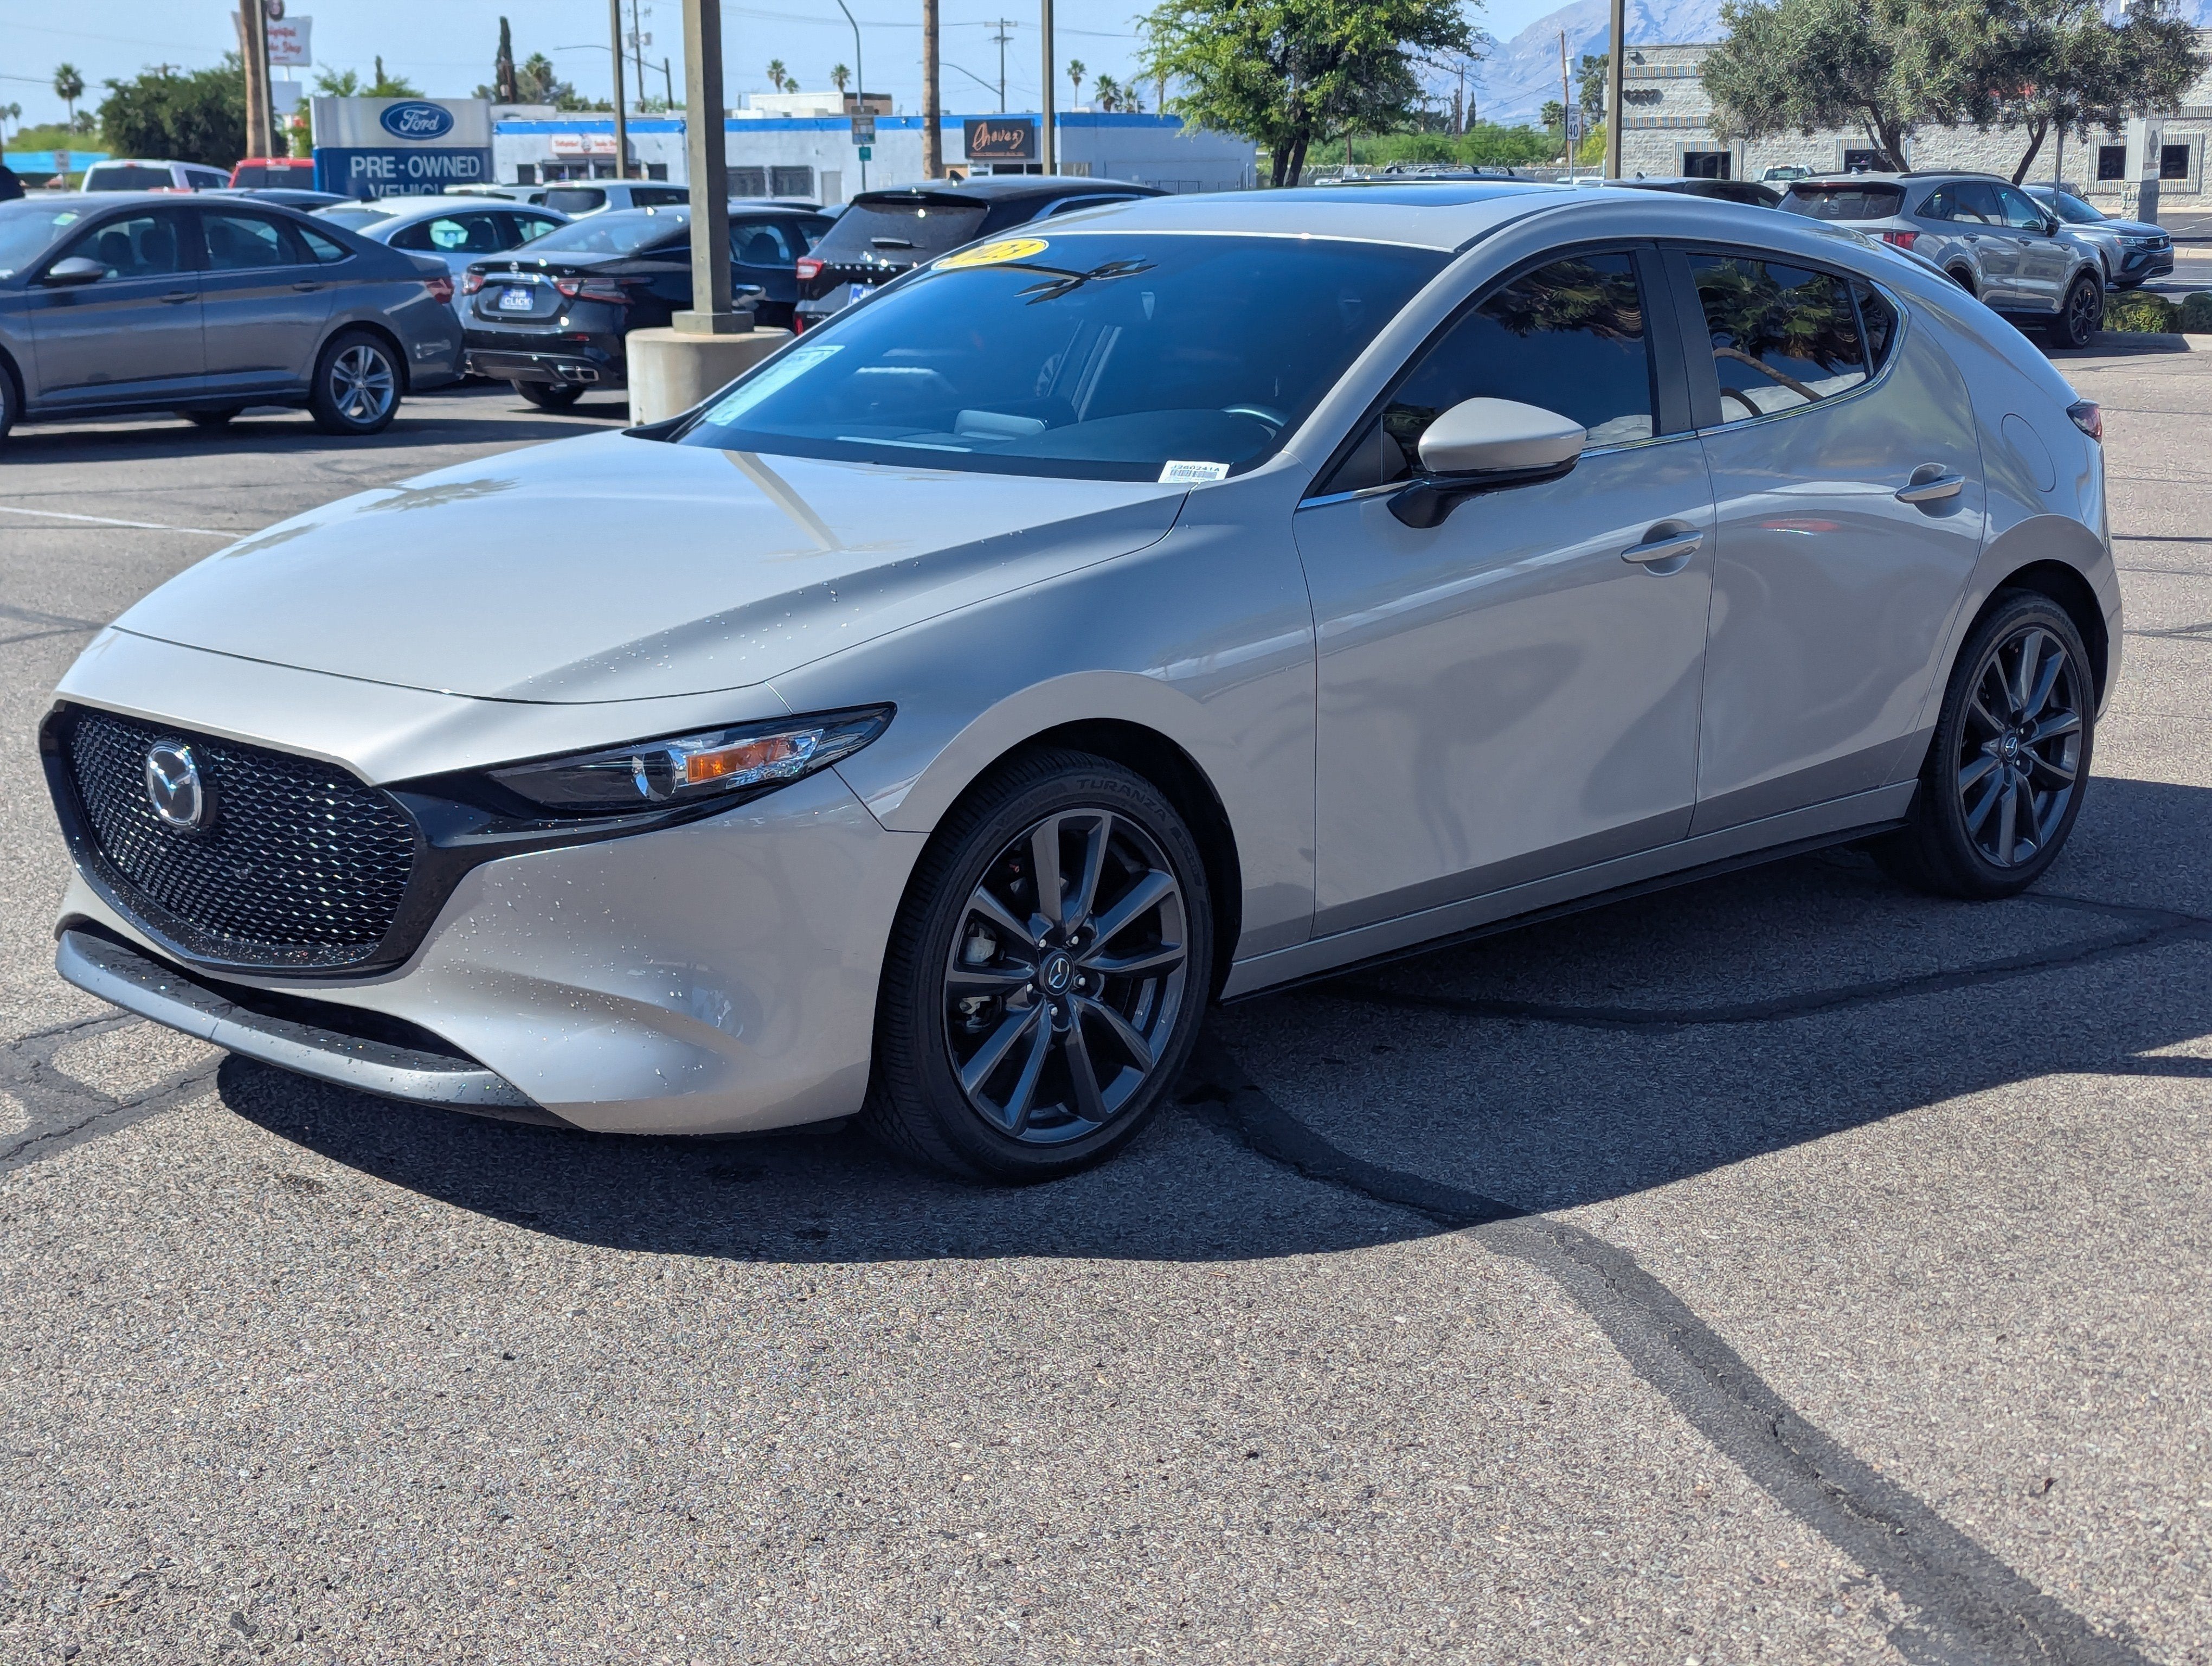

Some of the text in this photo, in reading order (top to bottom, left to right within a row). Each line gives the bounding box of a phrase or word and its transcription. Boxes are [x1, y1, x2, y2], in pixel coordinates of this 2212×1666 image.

[400, 109, 440, 131] Ford
[1568, 124, 1578, 137] 40
[350, 156, 480, 178] PRE-OWNED
[369, 183, 441, 197] VEHICL
[504, 297, 530, 306] CLICK
[1077, 778, 1166, 822] TURANZA
